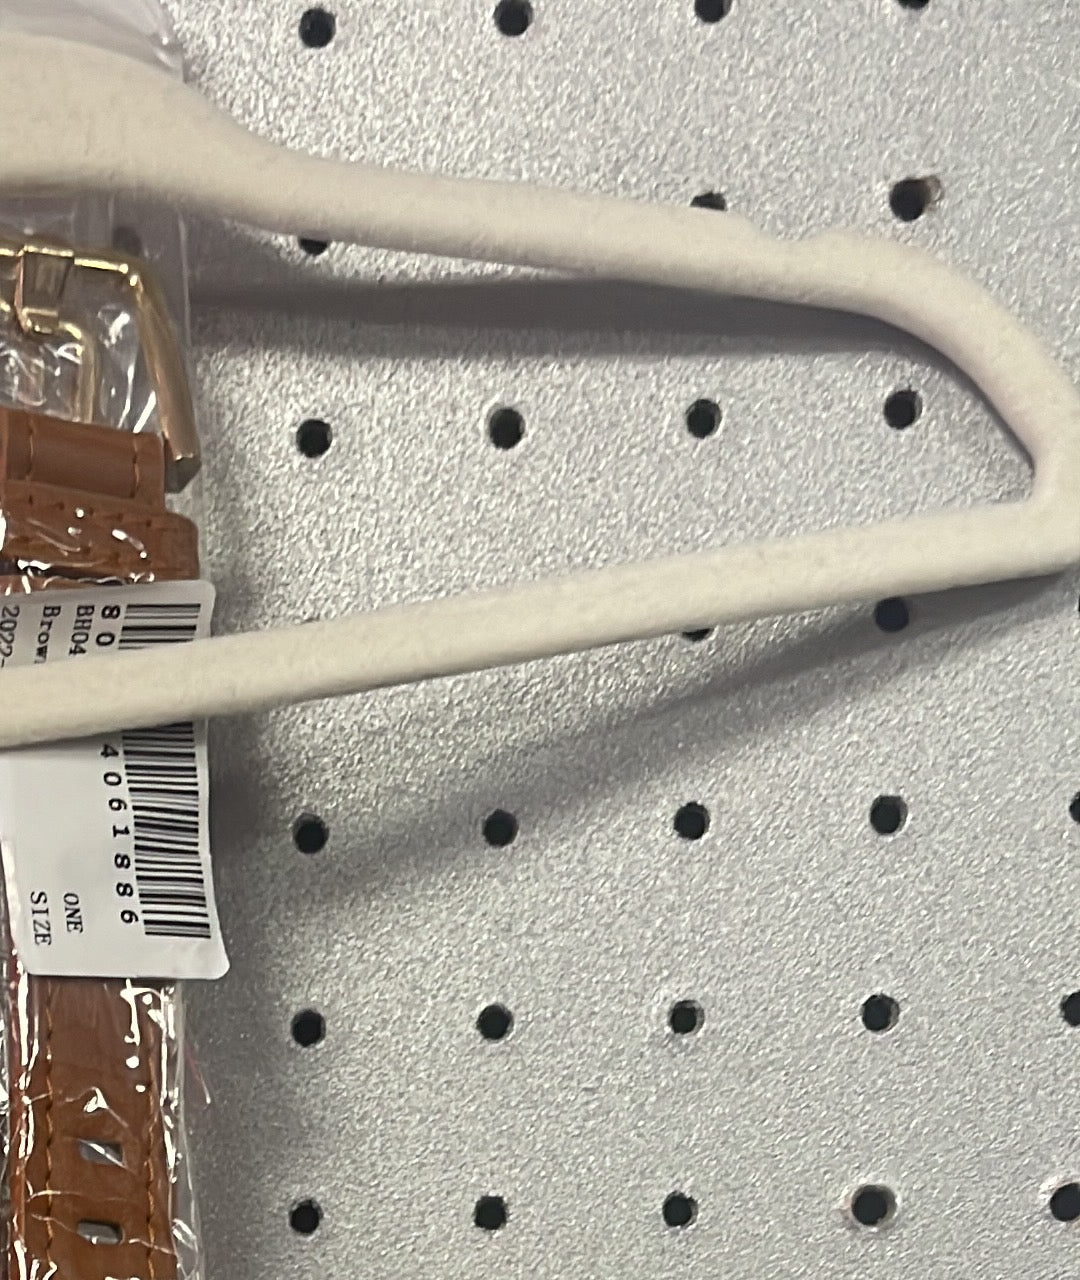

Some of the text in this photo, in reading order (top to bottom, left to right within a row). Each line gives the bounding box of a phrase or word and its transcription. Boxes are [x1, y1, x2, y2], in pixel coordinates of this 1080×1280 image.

[69, 604, 95, 656] BH04
[30, 890, 52, 946] SIZE
[63, 892, 83, 934] ONE
